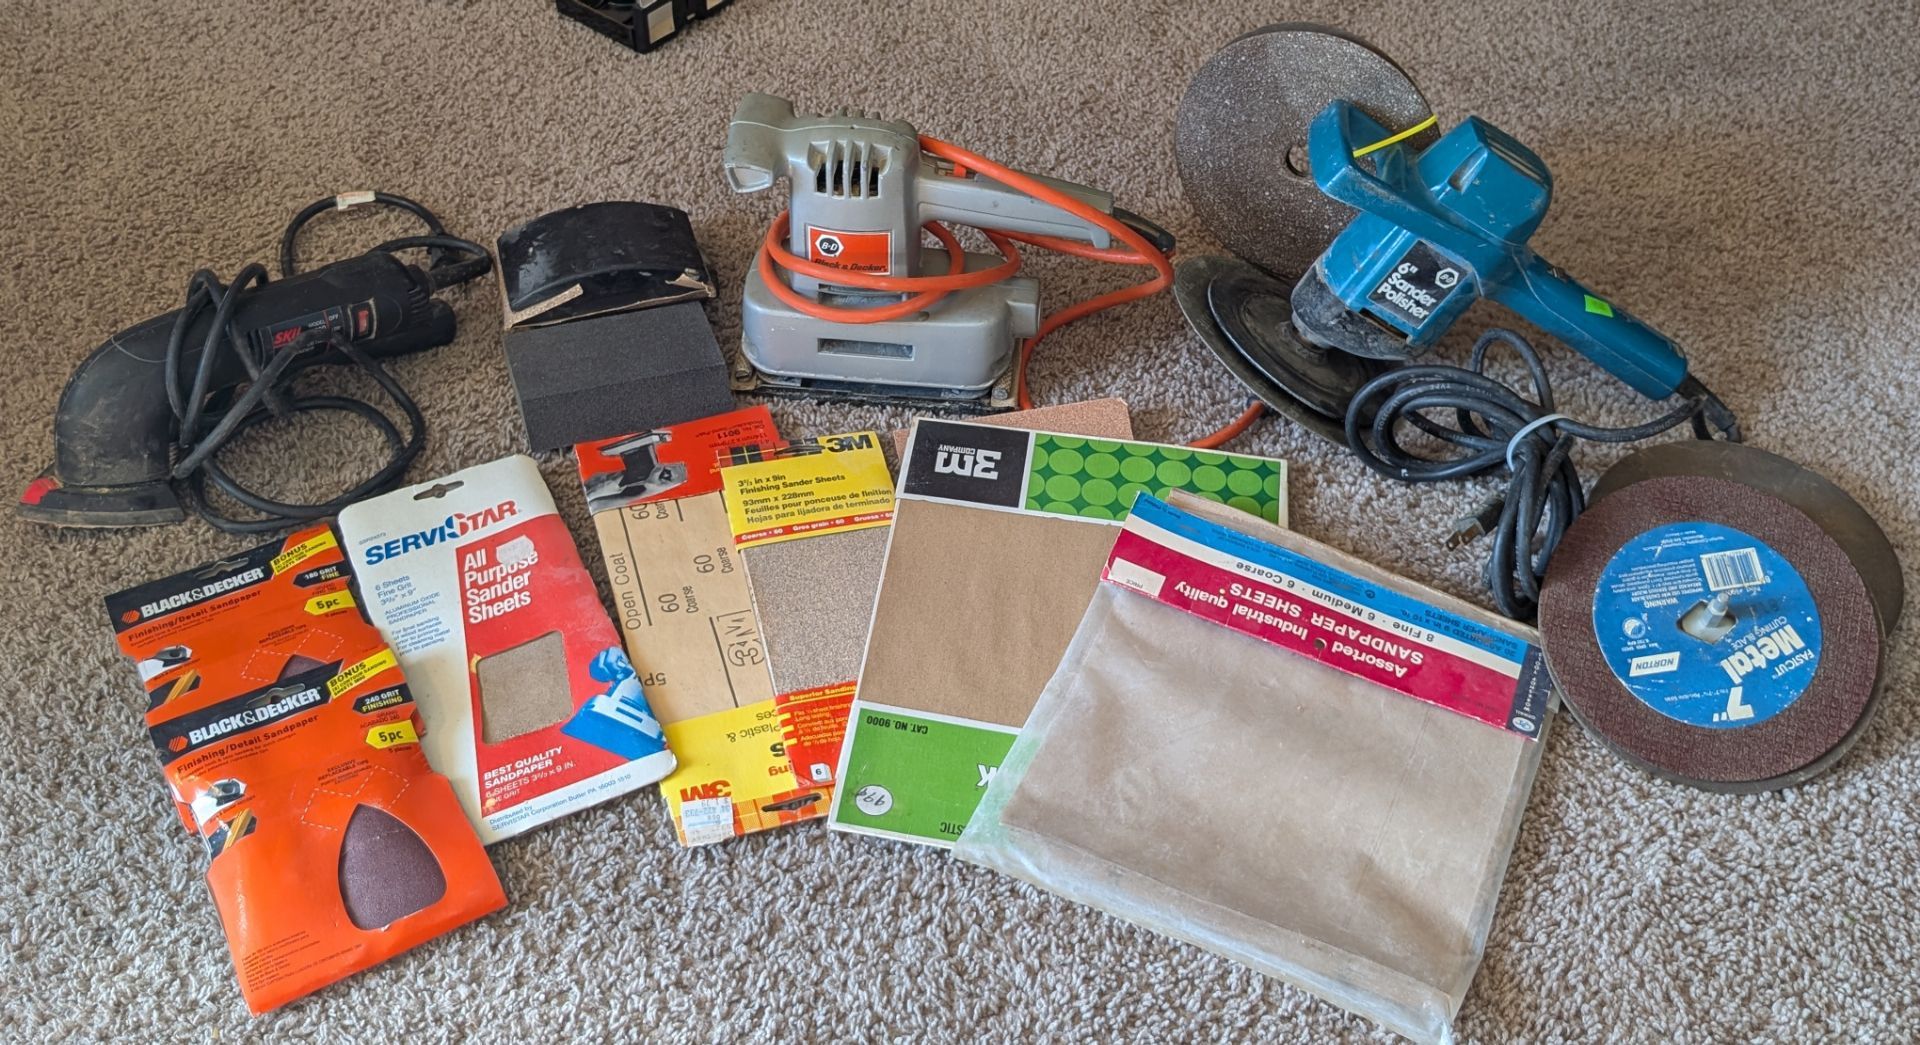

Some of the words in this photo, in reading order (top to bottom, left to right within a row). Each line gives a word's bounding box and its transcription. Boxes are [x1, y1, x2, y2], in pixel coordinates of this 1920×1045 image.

[814, 258, 841, 270] Black
[850, 264, 885, 272] Decker
[1397, 262, 1418, 276] 6"
[1386, 271, 1437, 308] Sander
[1376, 282, 1430, 320] Polisher
[717, 429, 741, 439] 9011
[826, 434, 874, 453] 3M
[937, 444, 976, 454] COMPANY
[740, 482, 781, 496] Finishing
[782, 477, 814, 489] Sander
[815, 474, 845, 485] Sheets
[754, 476, 763, 485] in
[742, 497, 771, 508] 93mm
[781, 490, 814, 501] 228mm
[745, 503, 781, 515] Feuilles
[782, 502, 802, 513] pour
[804, 494, 847, 509] ponceuse
[849, 491, 860, 499] de
[862, 488, 892, 499] finition
[629, 503, 650, 520] 60
[746, 513, 773, 525] Hojas
[775, 510, 795, 521] para
[797, 504, 831, 516] lijadora
[833, 501, 844, 510] de
[846, 496, 891, 509] terminado
[365, 500, 518, 566] SERVISTAR
[741, 531, 767, 541] Coarse
[792, 523, 810, 532] Gros
[811, 520, 829, 531] grain
[273, 543, 308, 566] BONUS
[464, 548, 487, 573] All
[693, 554, 715, 574] 60
[717, 546, 734, 574] Coarse
[304, 572, 318, 580] 180
[319, 566, 337, 575] GRIT
[320, 571, 340, 581] FINE
[464, 549, 538, 589] Purpose
[610, 551, 631, 586] Coat
[1235, 561, 1283, 585] Coarse
[377, 588, 396, 599] Fine
[397, 582, 412, 592] Grit
[382, 575, 410, 588] Sheets
[466, 571, 532, 609] Sander
[1125, 578, 1145, 590] PRICE
[1287, 579, 1296, 589] 6
[140, 567, 265, 618] BLACK&DECKER
[210, 590, 261, 612] Sandpaper
[658, 593, 680, 613] 60
[682, 585, 700, 614] Coarse
[1173, 581, 1229, 609] quality
[1229, 582, 1303, 618] SHEETS
[1310, 588, 1364, 616] Medium
[1643, 597, 1679, 608] WARNING
[386, 599, 436, 620] PROFESSIONAL
[468, 590, 532, 625] Sheets
[623, 591, 642, 630] Open
[1367, 611, 1376, 622] 6
[1424, 609, 1461, 627] SHEETS
[1232, 603, 1309, 641] Industrial
[1392, 621, 1422, 639] Fine
[1752, 615, 1788, 640] CUTTING
[1310, 611, 1425, 666] SANDPAPER
[1426, 632, 1435, 642] 8
[1732, 630, 1755, 650] BLADE
[1331, 641, 1409, 679] Assorted
[1634, 656, 1676, 671] NORTON
[1719, 623, 1806, 686] Metal
[1774, 648, 1816, 677] FASTCUT
[330, 661, 367, 688] BONUS
[365, 695, 380, 705] 240
[380, 688, 400, 700] GRIT
[789, 691, 823, 701] Superior
[824, 685, 857, 695] Sanding
[361, 695, 403, 713] FINISHING
[1712, 685, 1755, 723] 7"
[188, 687, 322, 746] BLACK&DECKER
[866, 715, 890, 728] 9000
[893, 720, 909, 731] NO.
[725, 732, 737, 743] &
[741, 723, 781, 741] Plastic
[912, 725, 929, 735] CAT.
[176, 734, 262, 774] Finishing/Detail
[263, 714, 320, 742] Sandpaper
[483, 764, 513, 781] BEST
[514, 746, 563, 769] QUALITY
[484, 758, 553, 789] SANDPAPER
[815, 768, 822, 776] 6
[493, 776, 530, 797] SHEETS
[556, 765, 563, 773] 9
[563, 760, 577, 770] IN.
[503, 788, 521, 801] GRIT
[680, 780, 731, 802] 3M
[489, 809, 525, 825] Distributed
[525, 804, 534, 814] by
[491, 811, 531, 832] SERVISTAR
[530, 799, 568, 817] Corporation
[567, 791, 587, 802] Butler
[587, 787, 597, 795] PA
